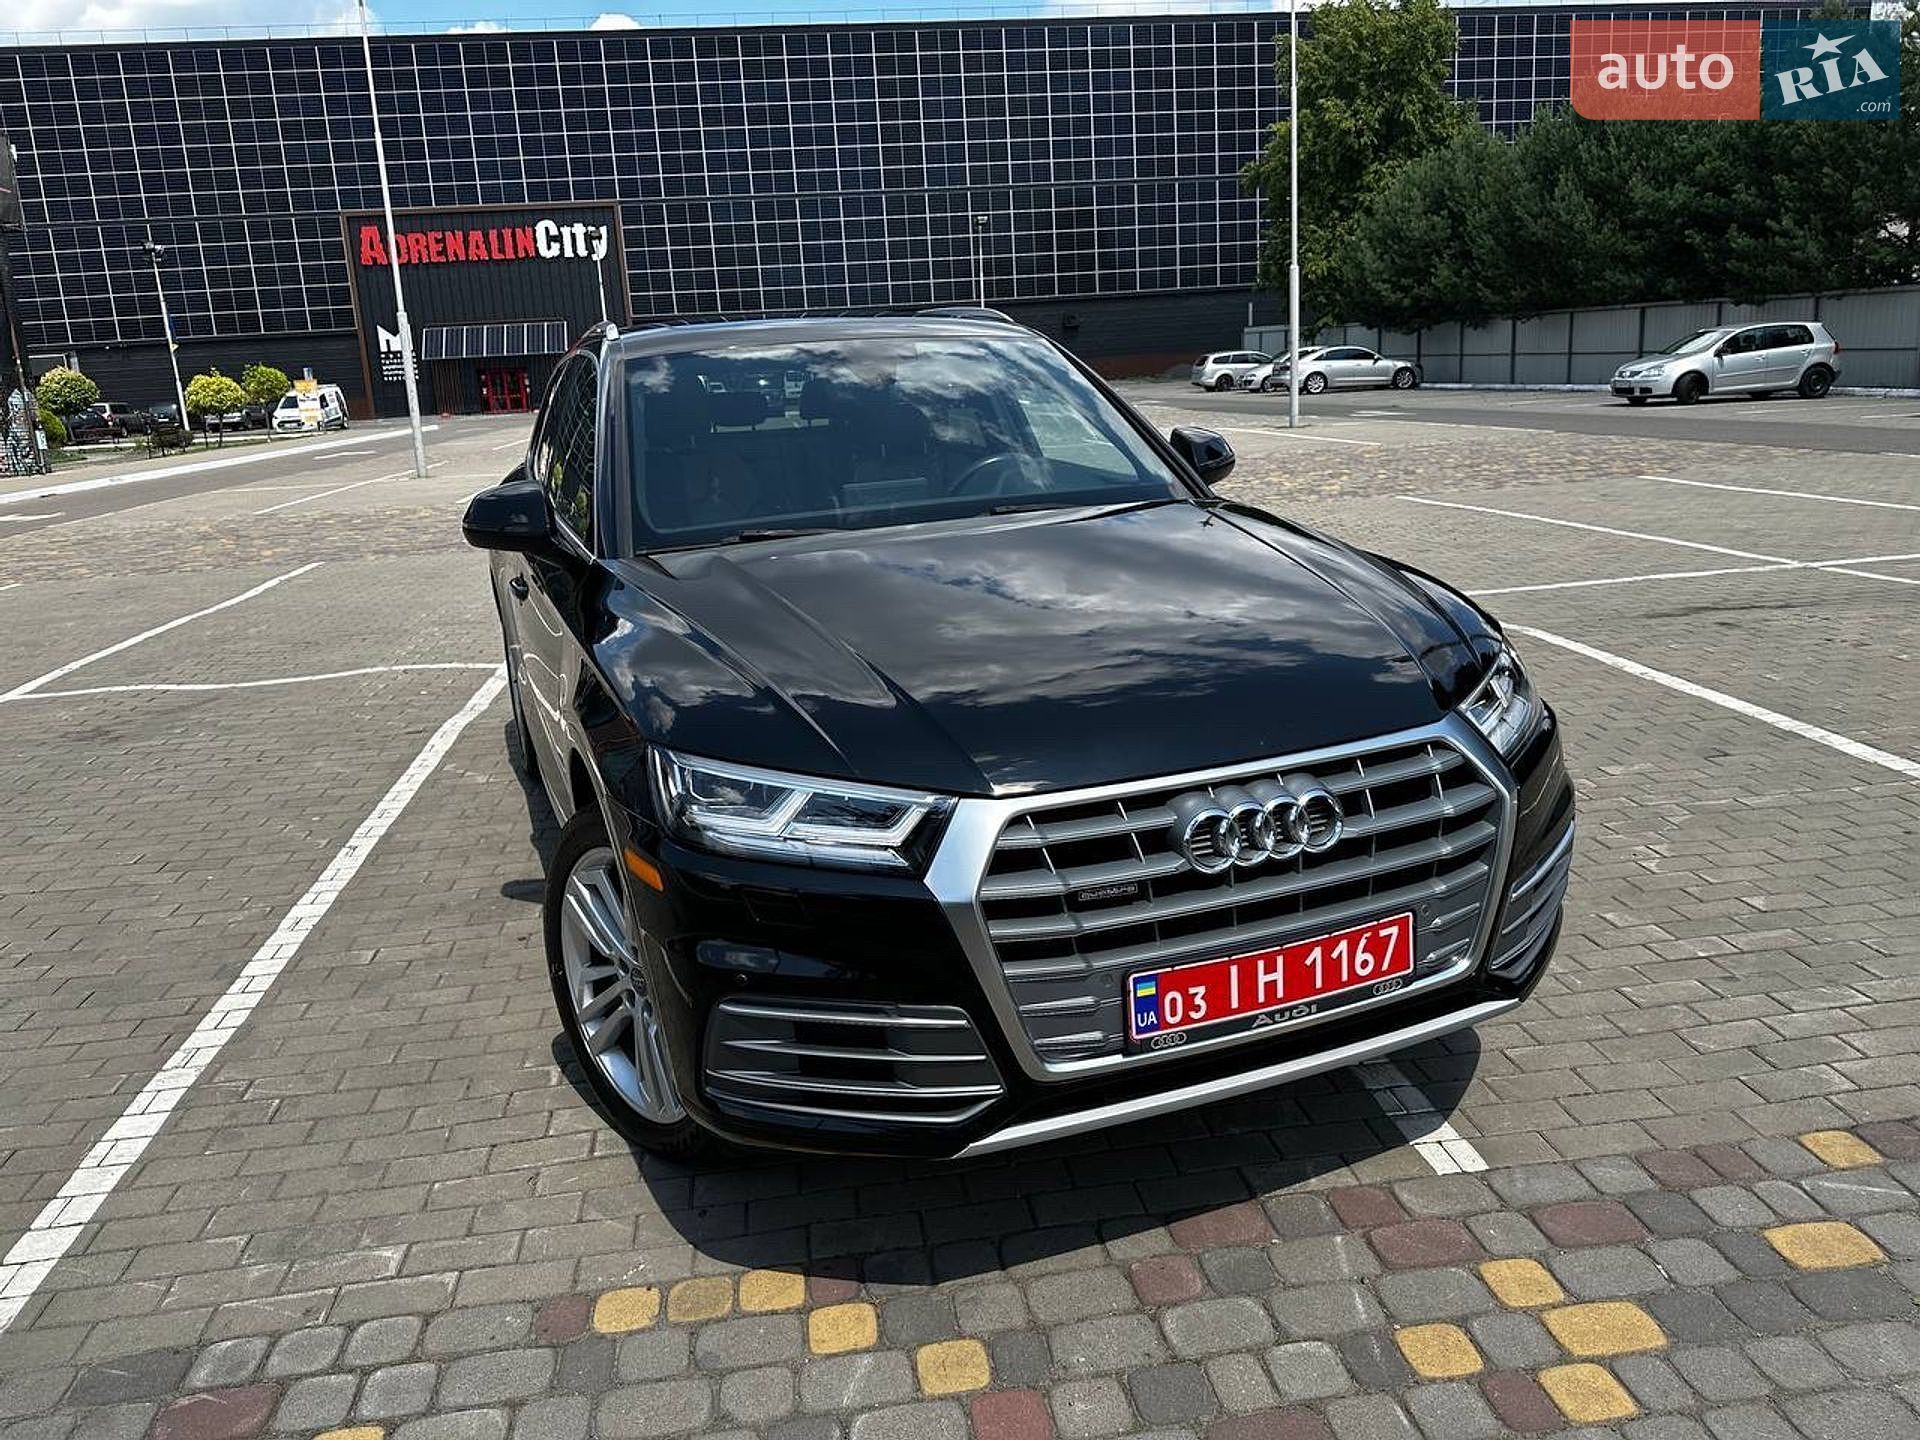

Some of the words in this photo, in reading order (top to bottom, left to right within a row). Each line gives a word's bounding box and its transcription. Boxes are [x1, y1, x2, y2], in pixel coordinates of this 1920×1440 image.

[1163, 985, 1208, 1025] 03
[1304, 925, 1400, 990] 1167
[1137, 1011, 1158, 1028] UA
